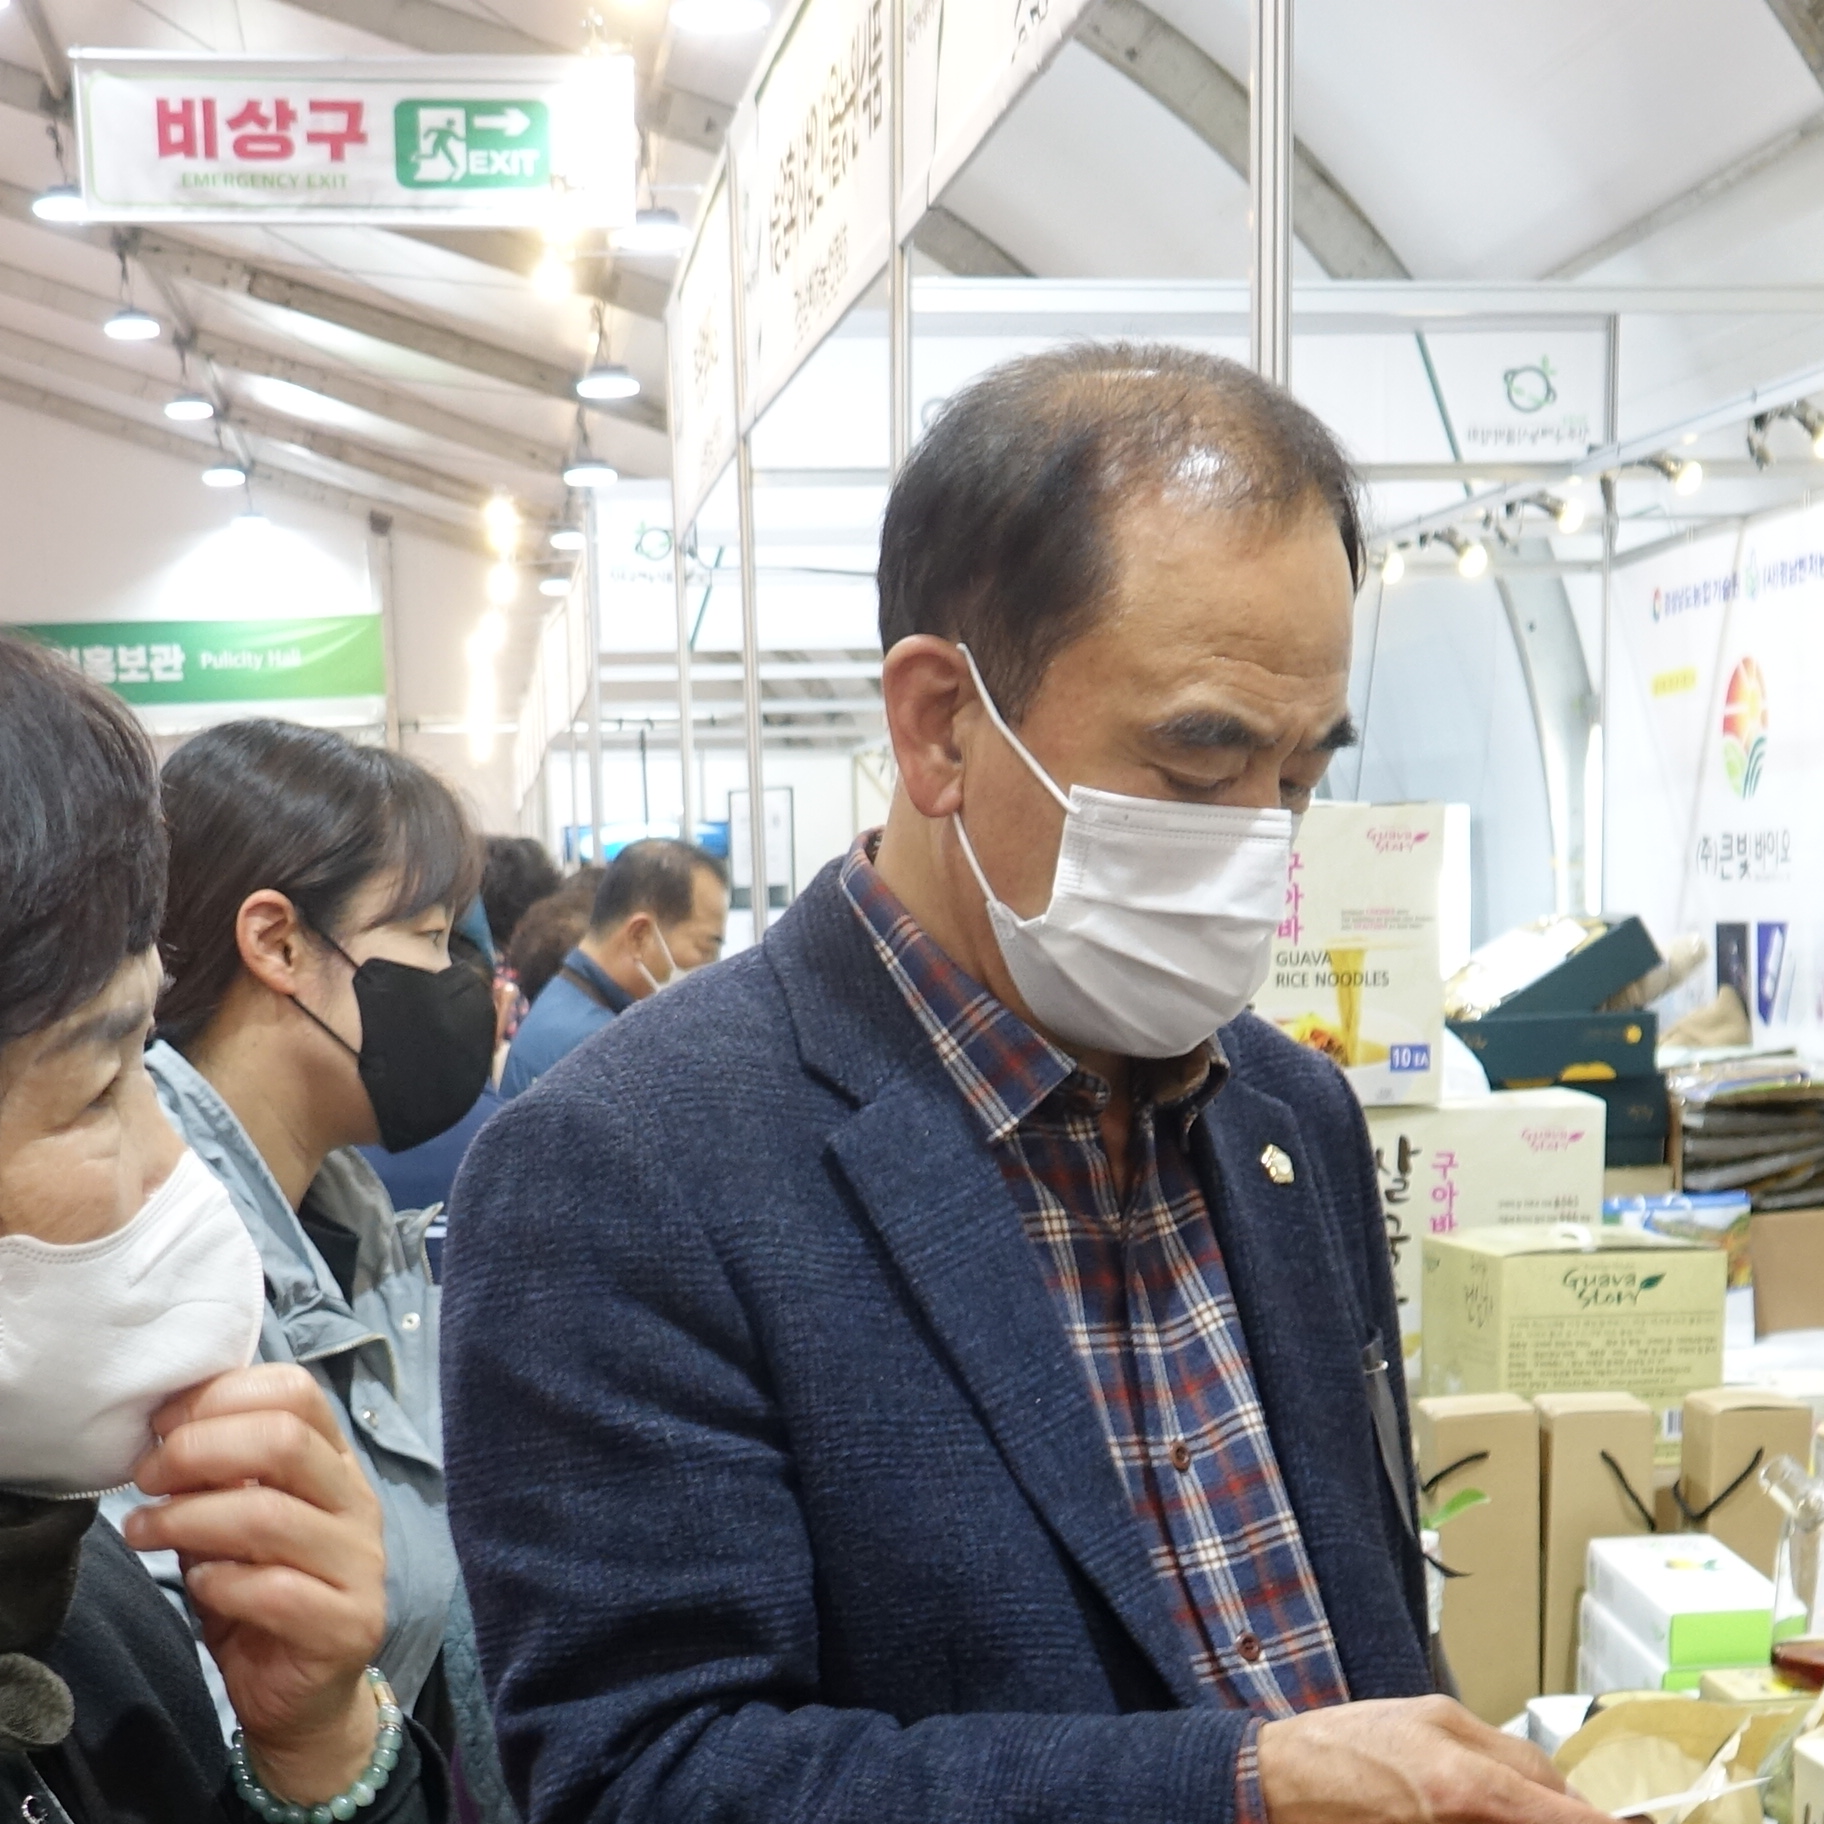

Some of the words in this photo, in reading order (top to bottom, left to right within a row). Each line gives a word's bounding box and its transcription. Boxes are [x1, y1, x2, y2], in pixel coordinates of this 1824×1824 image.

[154, 97, 369, 164] 비상구
[468, 148, 542, 177] EXIT
[181, 172, 301, 190] EMERGENCY
[306, 172, 349, 190] EXIT
[1275, 950, 1333, 967] GUAVA
[1275, 971, 1310, 989] RICE
[1314, 970, 1390, 988] NOODLES
[1392, 1046, 1411, 1068] 10
[1430, 1151, 1459, 1234] 구아바
[1562, 1268, 1637, 1290] Guava
